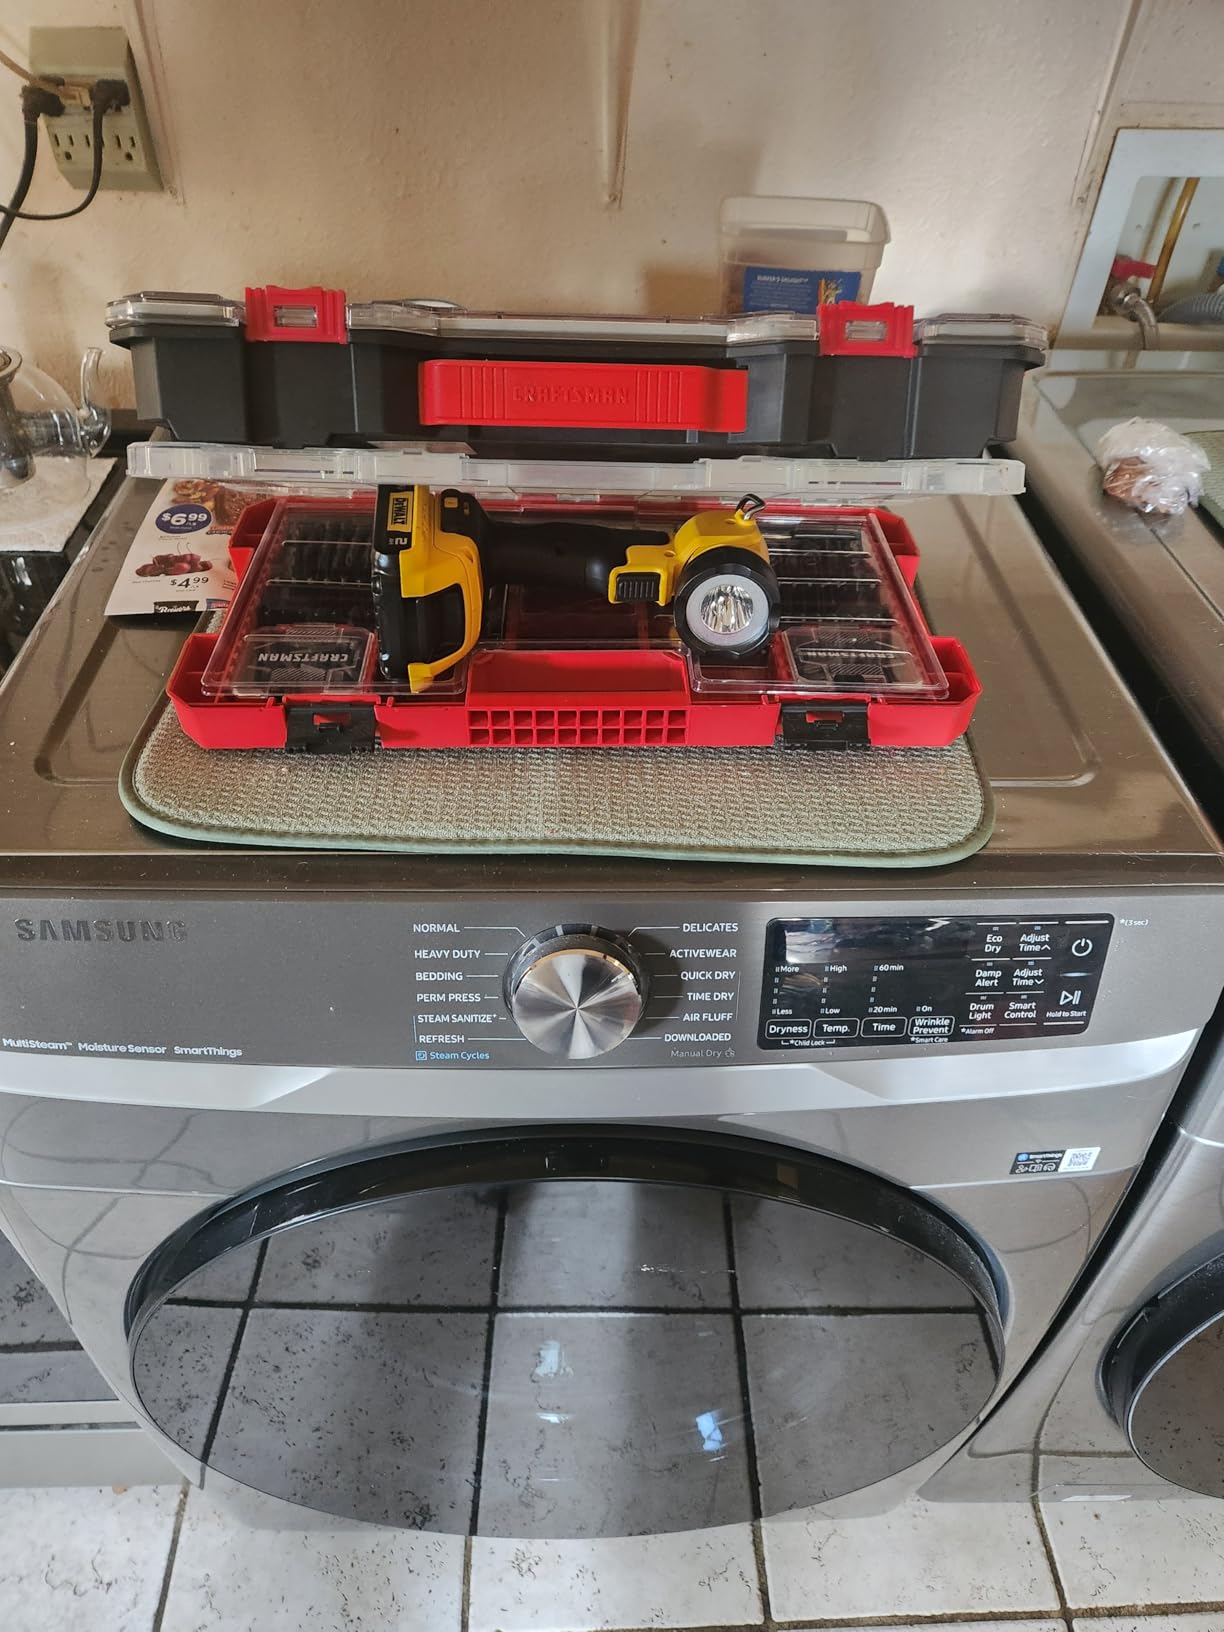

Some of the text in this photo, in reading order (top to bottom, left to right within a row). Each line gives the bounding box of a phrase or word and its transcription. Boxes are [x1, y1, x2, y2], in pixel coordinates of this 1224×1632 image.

[512, 383, 629, 405] CRAFTSMAN
[393, 497, 408, 525] DEWALT
[258, 653, 349, 662] CRAFTSMAN
[14, 918, 188, 943] SAMSUNG
[413, 923, 460, 933] NORMAL
[682, 923, 738, 932] DELICATES
[986, 934, 1002, 942] Eco
[1020, 933, 1050, 943] Adjust
[984, 944, 1001, 953] Dry
[1019, 943, 1041, 951] Time
[414, 949, 481, 959] HEAVY DUTY
[669, 949, 737, 959] ACTIVEWEAR
[829, 965, 847, 973] High
[975, 969, 1001, 978] Damp
[1013, 968, 1043, 978] Adjust
[415, 971, 463, 981] BEDDING
[680, 971, 736, 981] QUICK DRY
[975, 979, 998, 987] Alert
[1012, 978, 1034, 986] Time
[416, 993, 481, 1003] PERM PRESS
[686, 992, 734, 1001] TIME DRY
[1008, 1002, 1036, 1010] Smart
[417, 1014, 450, 1023] STEAM
[682, 1013, 733, 1022] AIR FLUFF
[968, 1011, 992, 1020] Light
[1004, 1010, 1036, 1018] Control
[914, 1017, 950, 1026] Wrinkle
[769, 1024, 808, 1036] Dryness
[822, 1024, 850, 1035] Temp.
[872, 1022, 896, 1031] Time
[912, 1026, 949, 1034] Prevent
[419, 1034, 465, 1043] REFRESH
[664, 1033, 732, 1042] DOWNLOADED
[78, 1042, 127, 1053] Moisture
[127, 1044, 167, 1054] Sensor
[174, 1046, 243, 1058] SmartThings
[670, 1049, 722, 1058] Manual Dry
[429, 1051, 490, 1061] Steam Cycles
